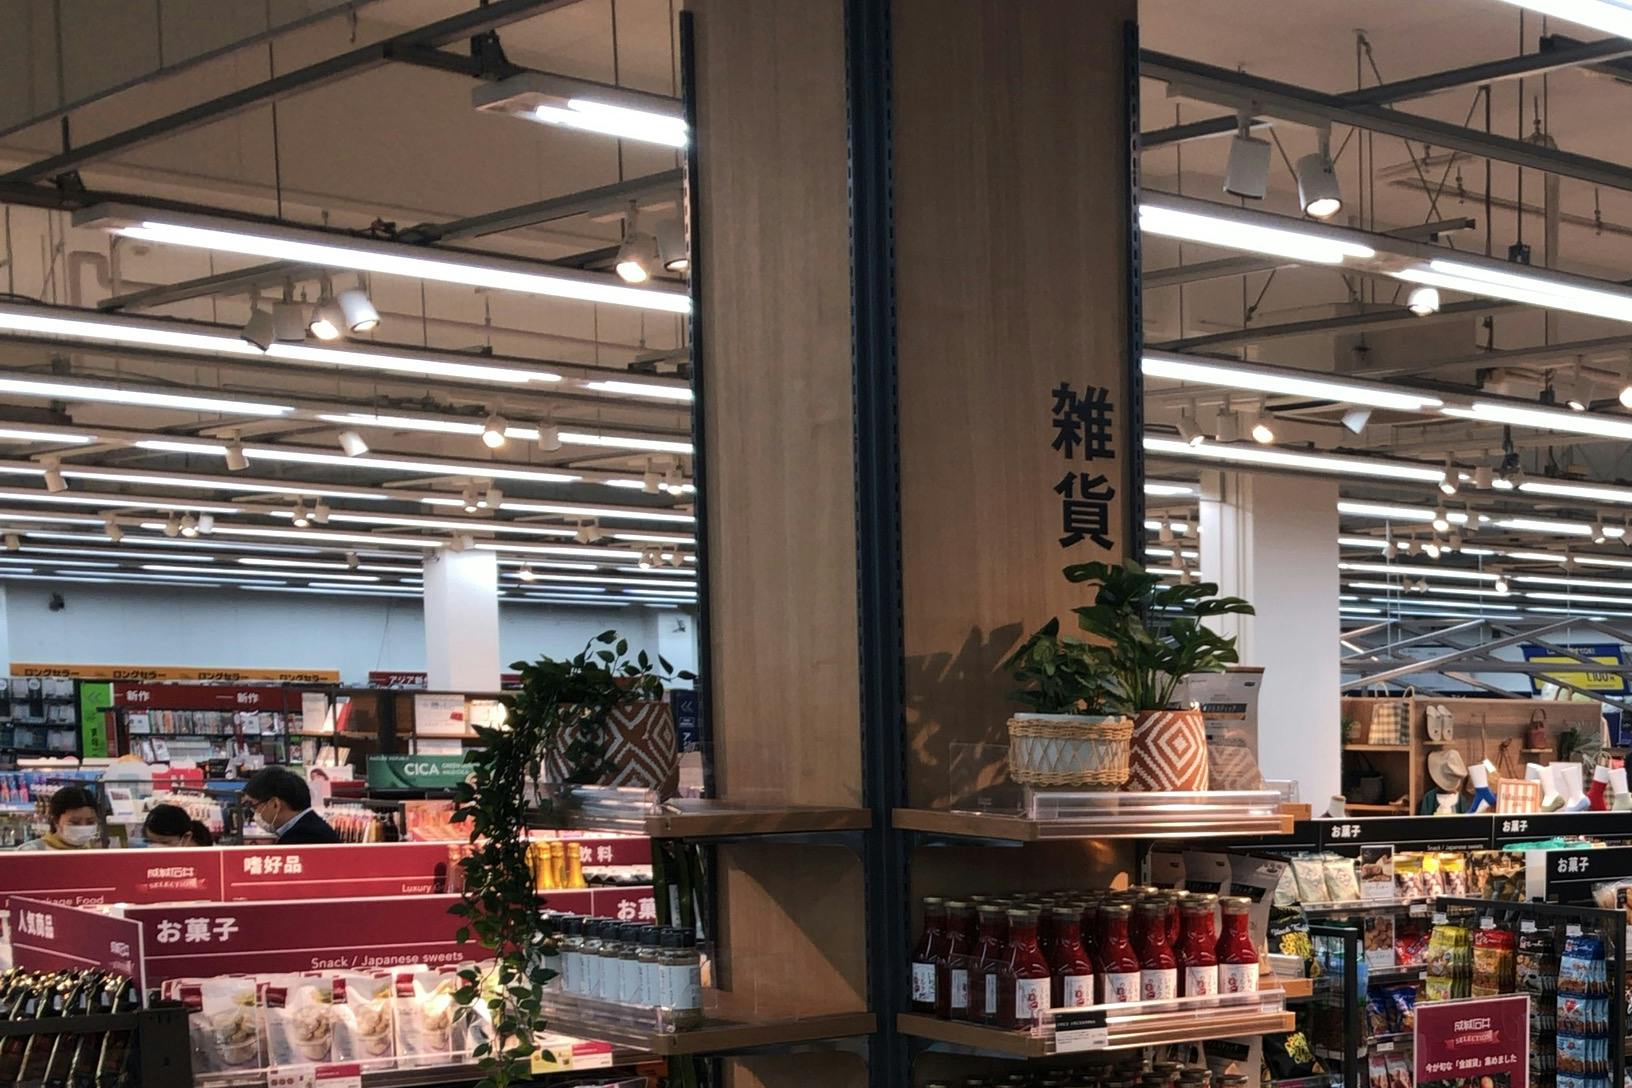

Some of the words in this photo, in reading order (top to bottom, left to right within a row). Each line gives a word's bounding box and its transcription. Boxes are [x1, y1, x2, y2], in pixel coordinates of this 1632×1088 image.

[1052, 381, 1115, 550] 雑貨
[25, 668, 79, 677] ロングセラー
[113, 670, 166, 679] ロングセラー
[198, 672, 249, 681] ロングセラー
[279, 673, 328, 681] ロングセラー
[126, 690, 150, 701] 新作
[237, 691, 259, 703] 新作
[404, 763, 440, 775] CICA
[1331, 824, 1361, 838] お菓子
[1502, 820, 1528, 833] お菓子
[243, 855, 302, 874] 嗜好品
[1557, 856, 1589, 873] お菓子
[402, 883, 431, 894] Luxury
[75, 895, 104, 905] Food
[18, 909, 54, 939] 人気商品
[156, 918, 239, 943] お菓子
[311, 957, 347, 969] Snack
[351, 955, 358, 968] /
[361, 954, 419, 968] Japanese
[422, 951, 463, 964] sweets
[1454, 1018, 1491, 1031] 成城石井
[1455, 1030, 1493, 1044] SELECTION
